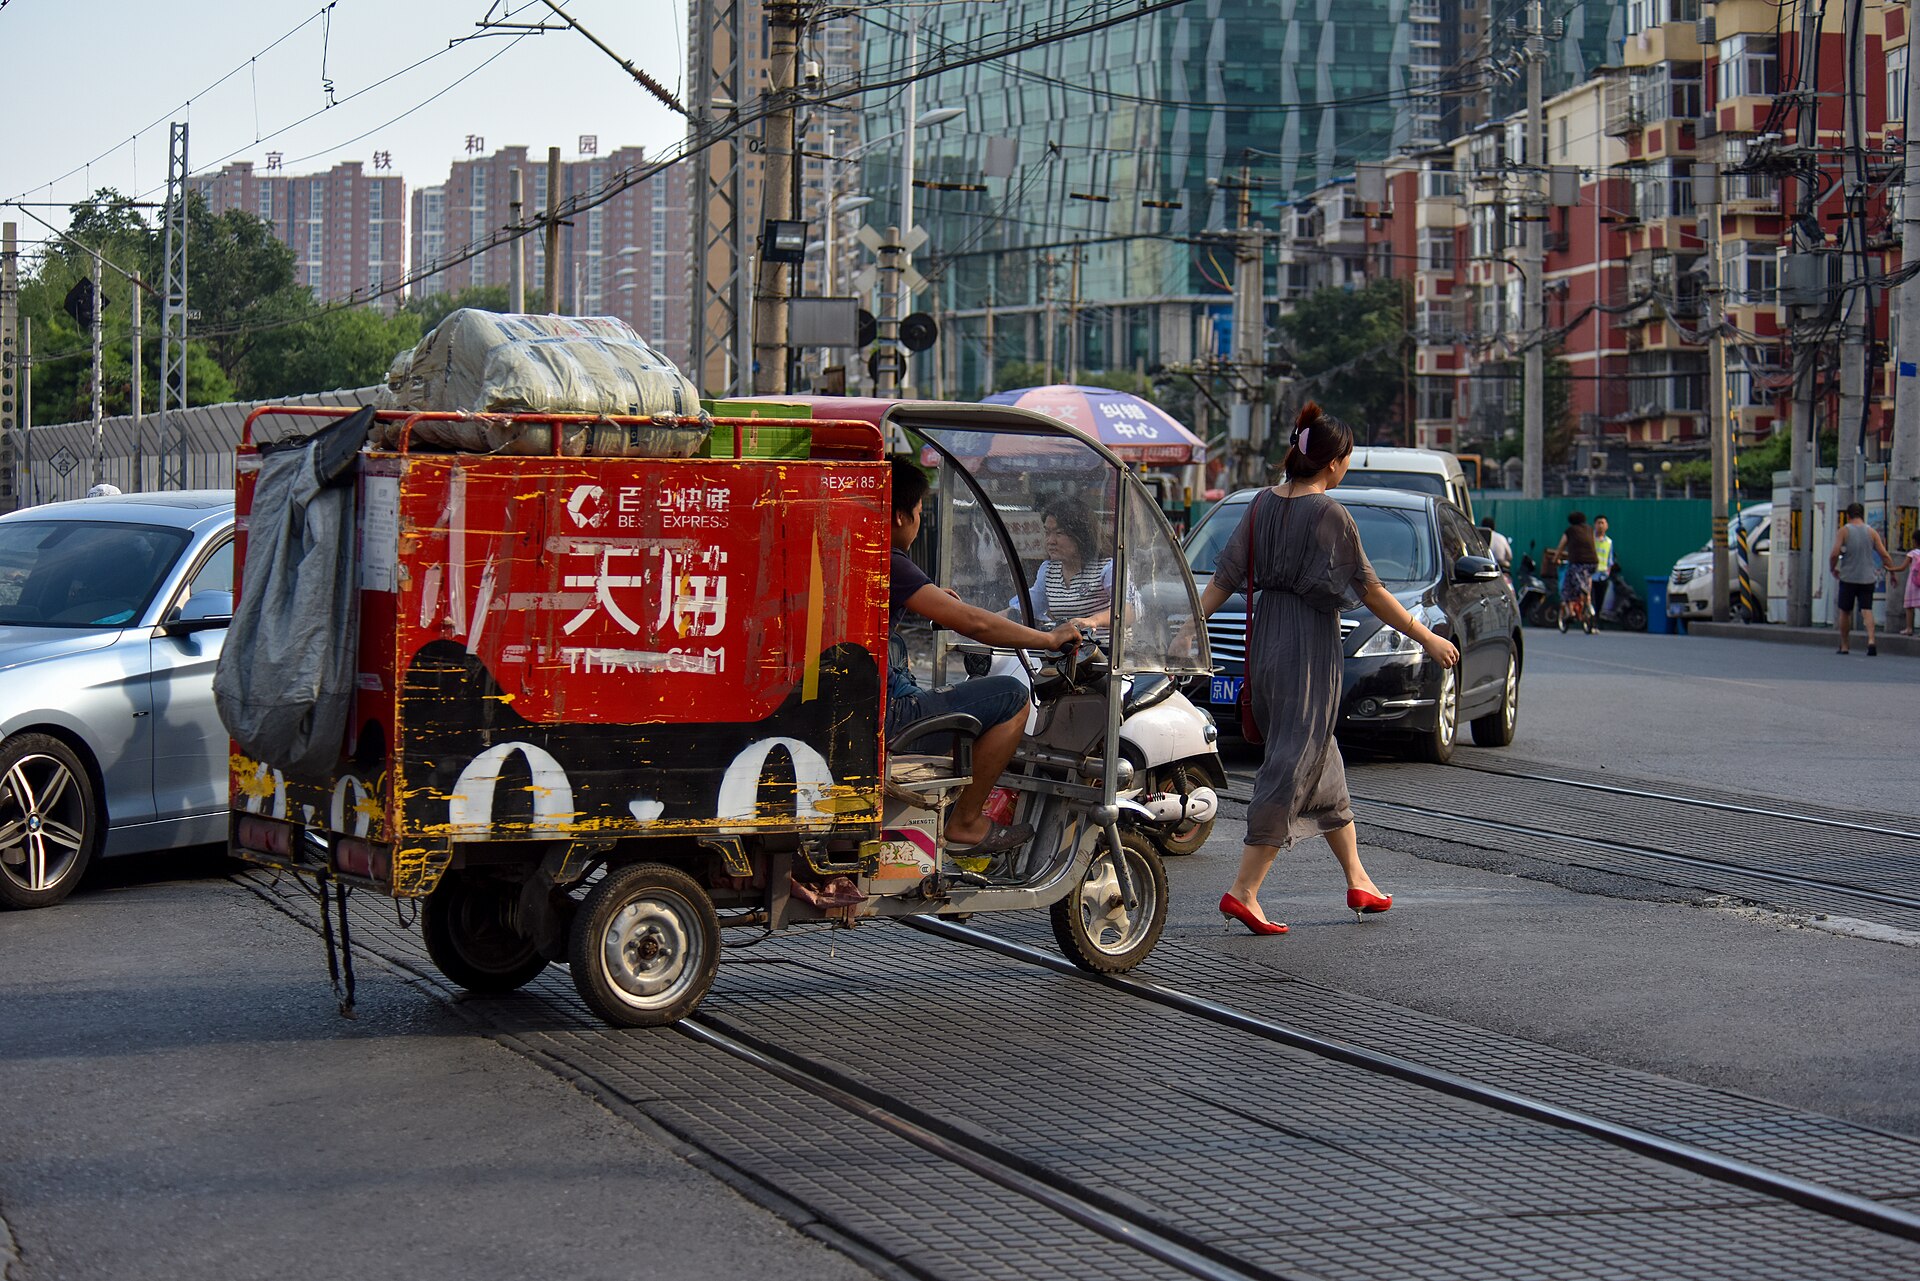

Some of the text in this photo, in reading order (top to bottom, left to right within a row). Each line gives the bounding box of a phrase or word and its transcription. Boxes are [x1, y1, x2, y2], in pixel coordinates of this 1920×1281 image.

[1099, 403, 1147, 419] 纠错
[1113, 421, 1158, 439] 中心
[821, 476, 875, 489] BEX2185
[663, 515, 729, 528] EXPRESS
[563, 545, 728, 637] 天猫
